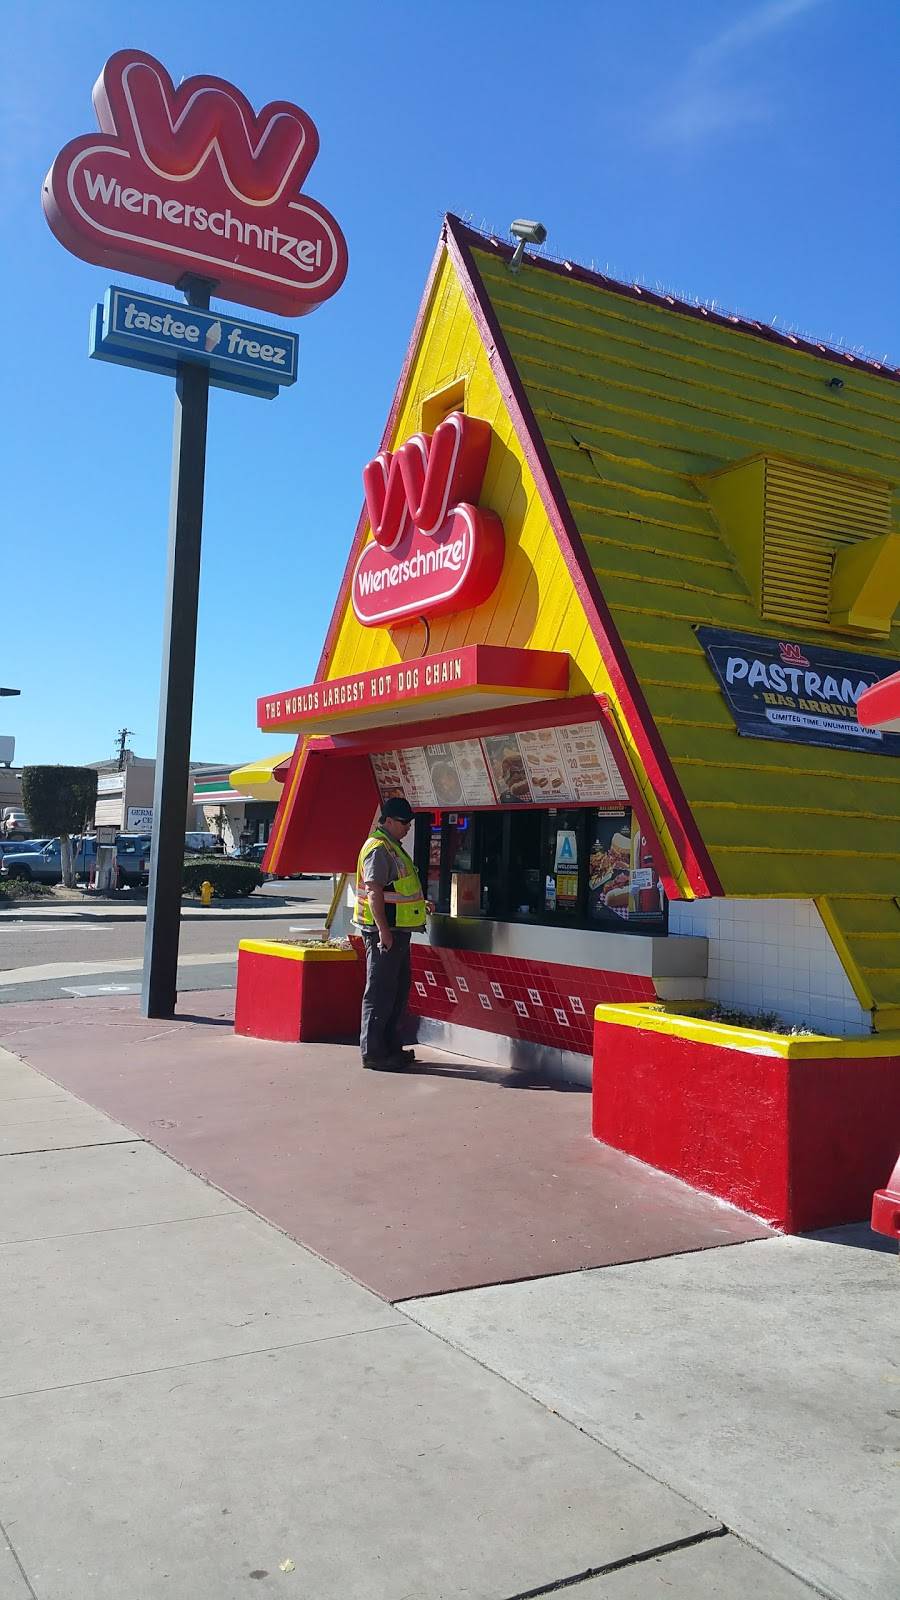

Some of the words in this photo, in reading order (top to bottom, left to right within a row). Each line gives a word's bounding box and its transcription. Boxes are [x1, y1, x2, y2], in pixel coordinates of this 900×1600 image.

[84, 169, 322, 272] Wienerschnitzel
[124, 302, 201, 343] tastee
[227, 328, 287, 365] freez
[358, 532, 467, 598] Wienerschnitzel
[265, 702, 282, 719] THE
[285, 691, 319, 715] WORLD'S
[322, 680, 365, 708] LARGEST
[370, 675, 392, 697] HOT
[398, 667, 419, 692] DOG
[425, 658, 462, 686] CHAIN
[726, 656, 874, 704] PASTRAM
[763, 692, 796, 708] HAS
[799, 698, 858, 718] ARRIVE
[771, 712, 800, 723] LIMITED
[802, 717, 822, 727] TIME.
[822, 720, 859, 733] UNLIMITED
[560, 837, 573, 857] A
